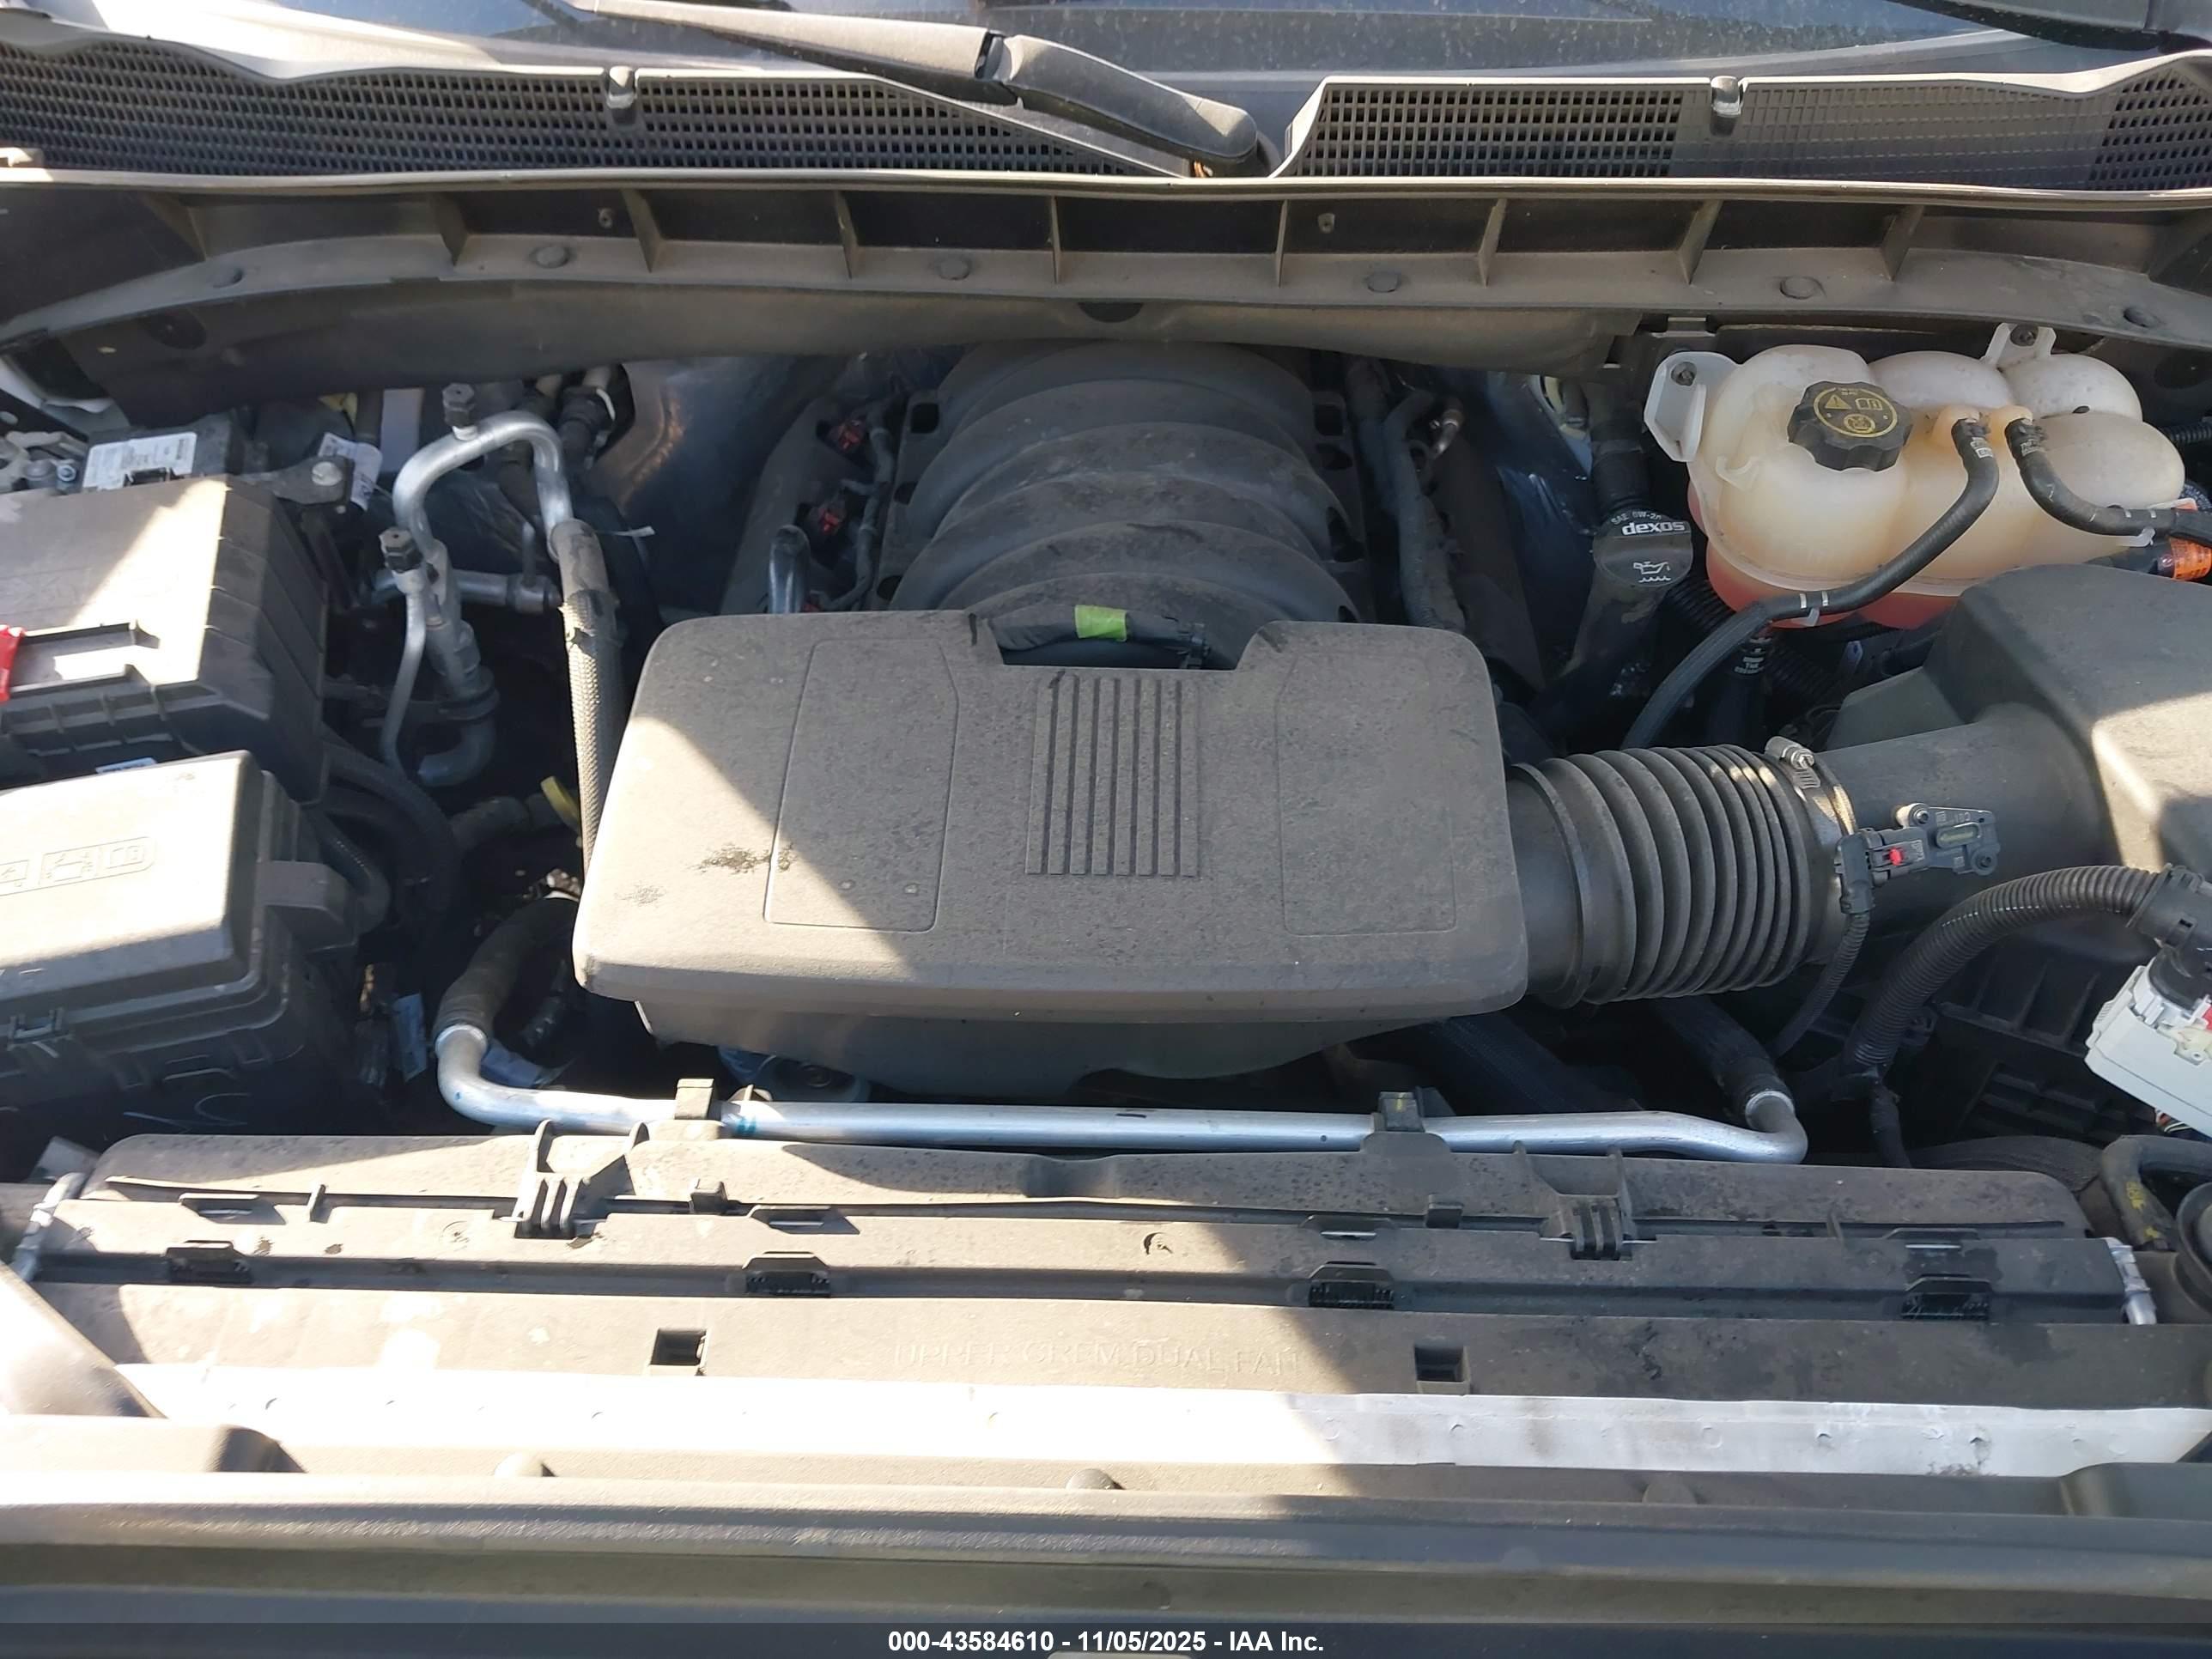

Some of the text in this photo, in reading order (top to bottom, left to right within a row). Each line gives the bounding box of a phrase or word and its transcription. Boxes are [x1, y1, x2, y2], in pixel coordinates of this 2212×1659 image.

[1621, 521, 1685, 536] dexos
[893, 1341, 1012, 1369] UPPER
[1132, 1341, 1225, 1373] DUAL
[1237, 1349, 1299, 1375] FAN
